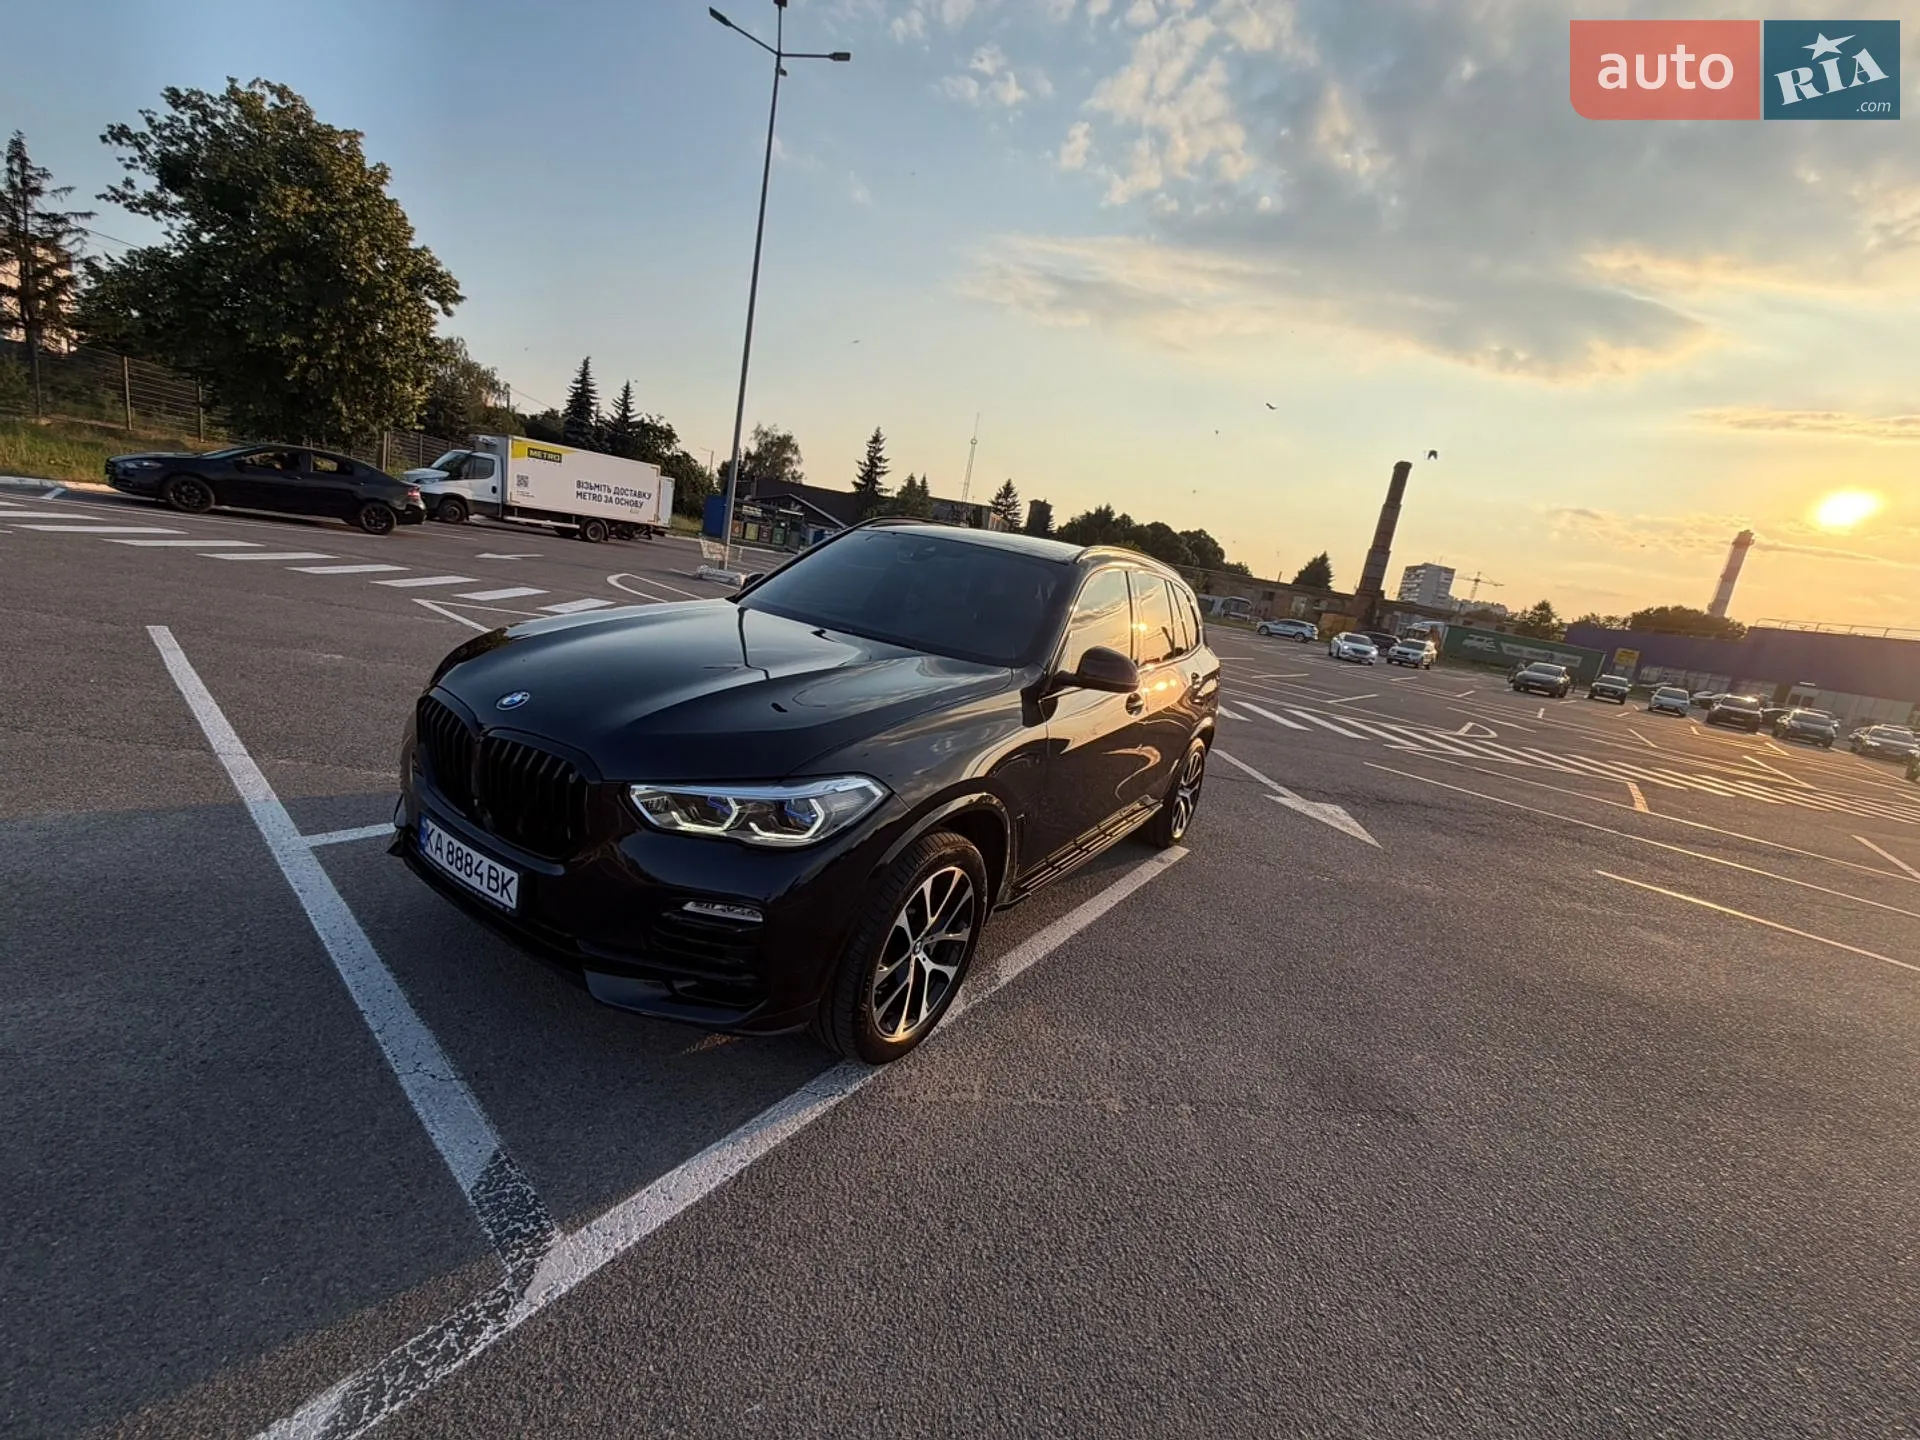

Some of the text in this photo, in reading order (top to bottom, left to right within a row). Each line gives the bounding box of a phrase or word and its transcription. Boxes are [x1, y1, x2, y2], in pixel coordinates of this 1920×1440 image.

[529, 449, 561, 462] METRO
[576, 479, 652, 500] ВІЗЬМІТЬ ДОСТАВКУ
[603, 494, 613, 505] ЗА
[614, 496, 644, 509] ОСНОВУ
[427, 828, 516, 904] KA 8884 BK
